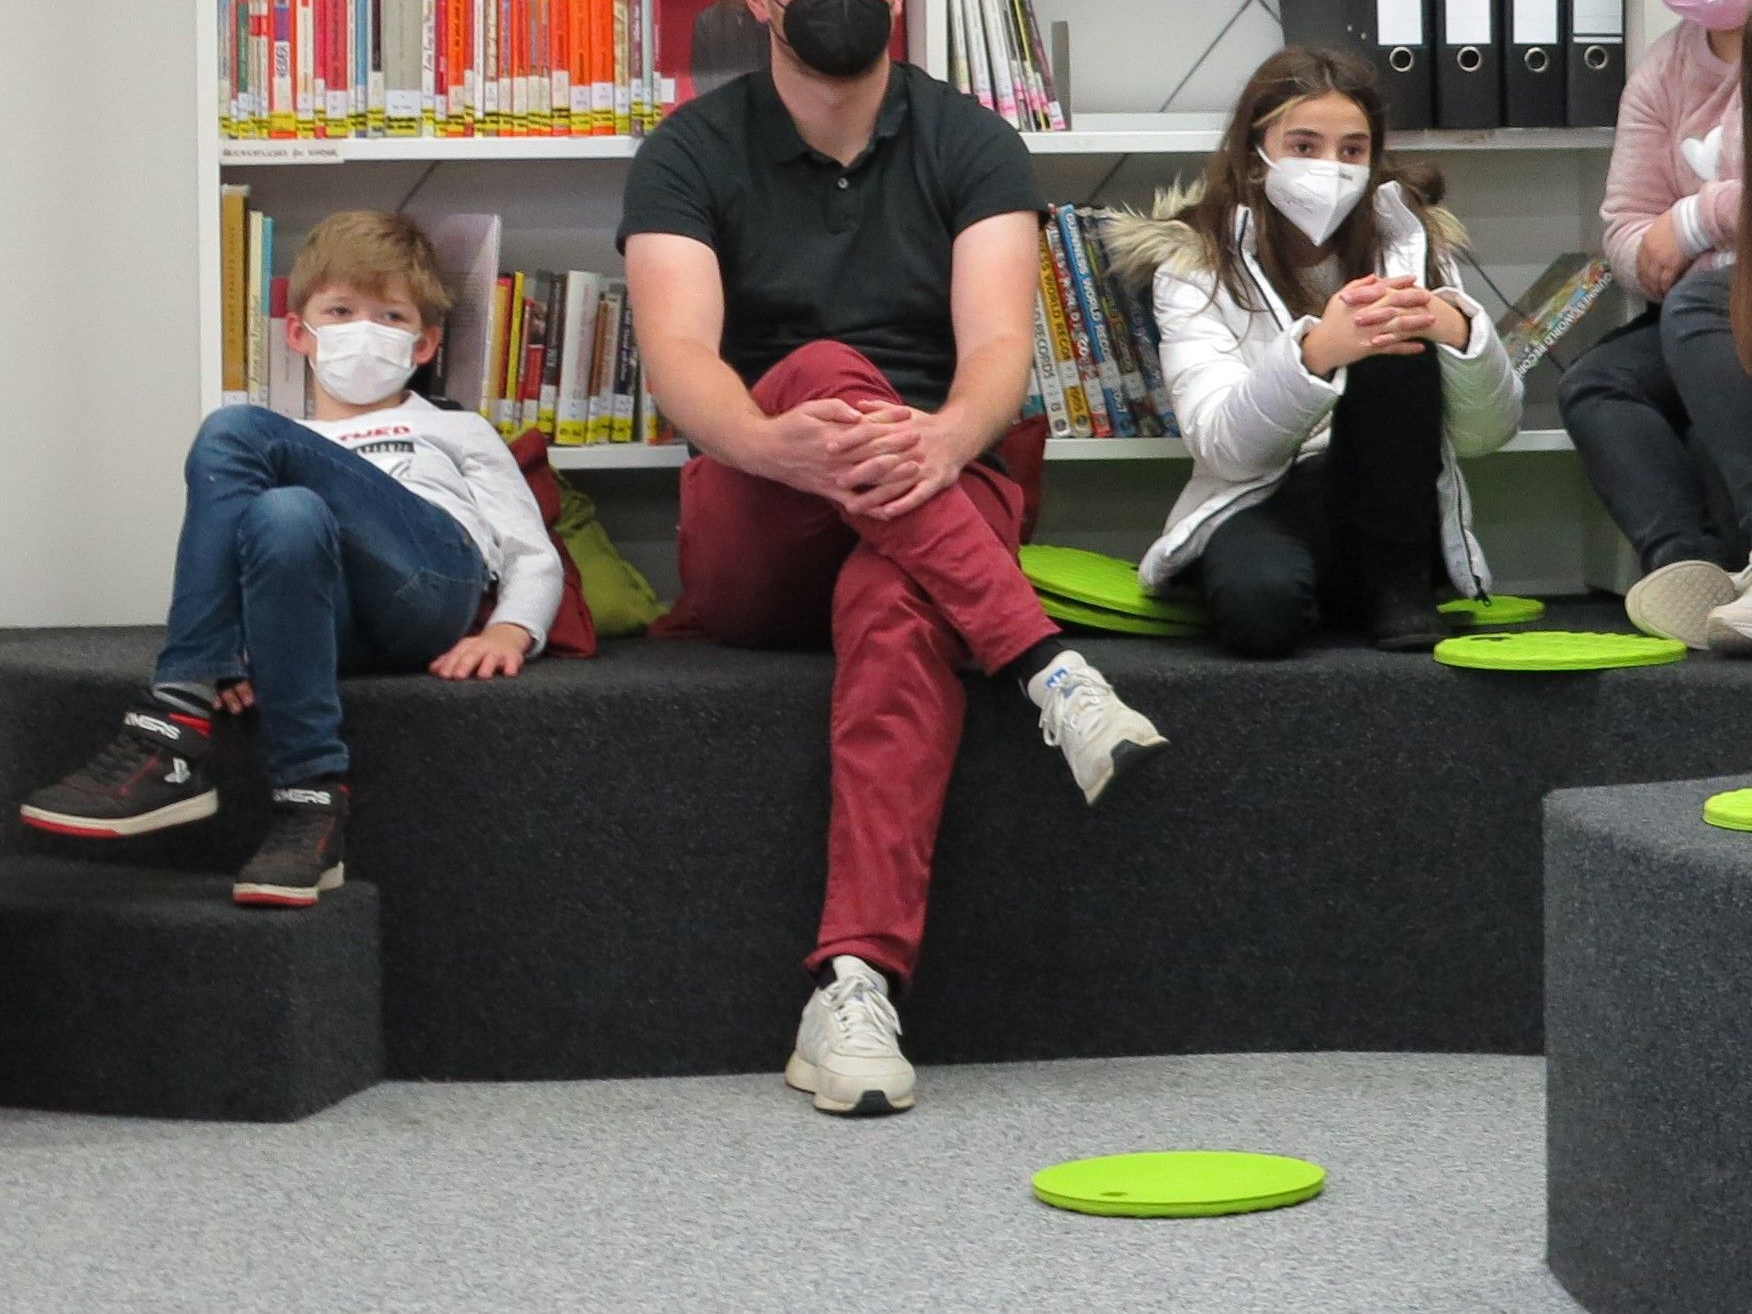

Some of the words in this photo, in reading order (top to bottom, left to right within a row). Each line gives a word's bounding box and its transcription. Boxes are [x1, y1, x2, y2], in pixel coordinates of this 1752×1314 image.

[1065, 213, 1088, 274] GUINNESS
[1082, 277, 1102, 321] WORLD
[1095, 324, 1111, 362] RECO
[1055, 322, 1072, 361] RECO
